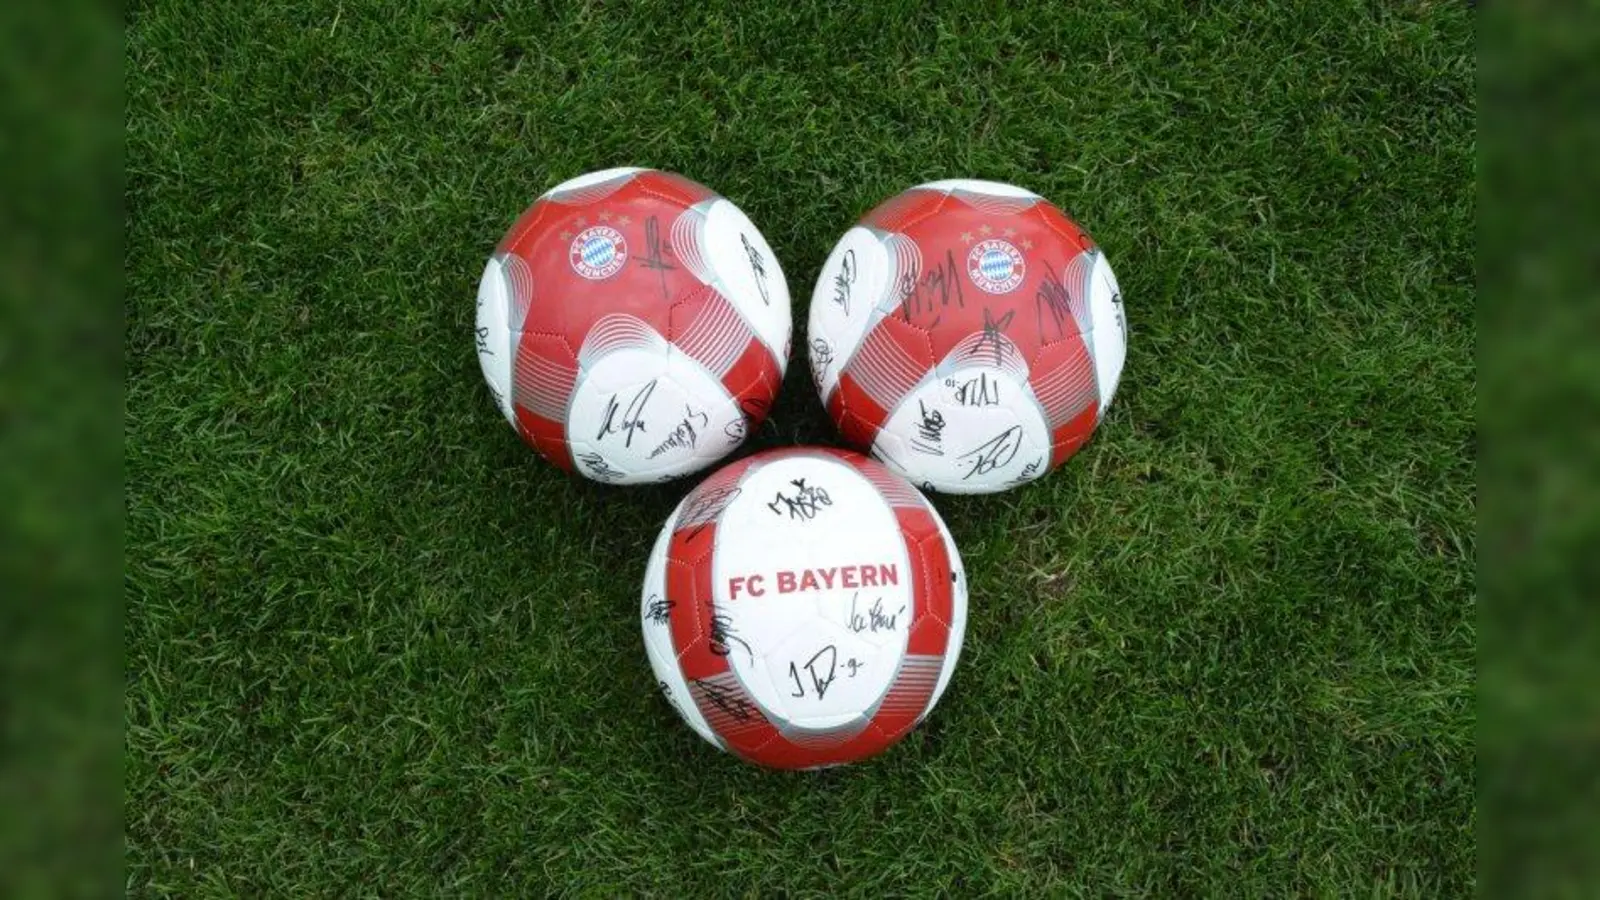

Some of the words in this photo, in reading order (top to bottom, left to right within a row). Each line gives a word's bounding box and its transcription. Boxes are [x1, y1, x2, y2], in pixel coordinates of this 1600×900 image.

[579, 228, 622, 245] BAYERN
[981, 241, 1023, 264] BAYERN
[728, 575, 766, 601] FC
[776, 563, 899, 594] BAYERN
